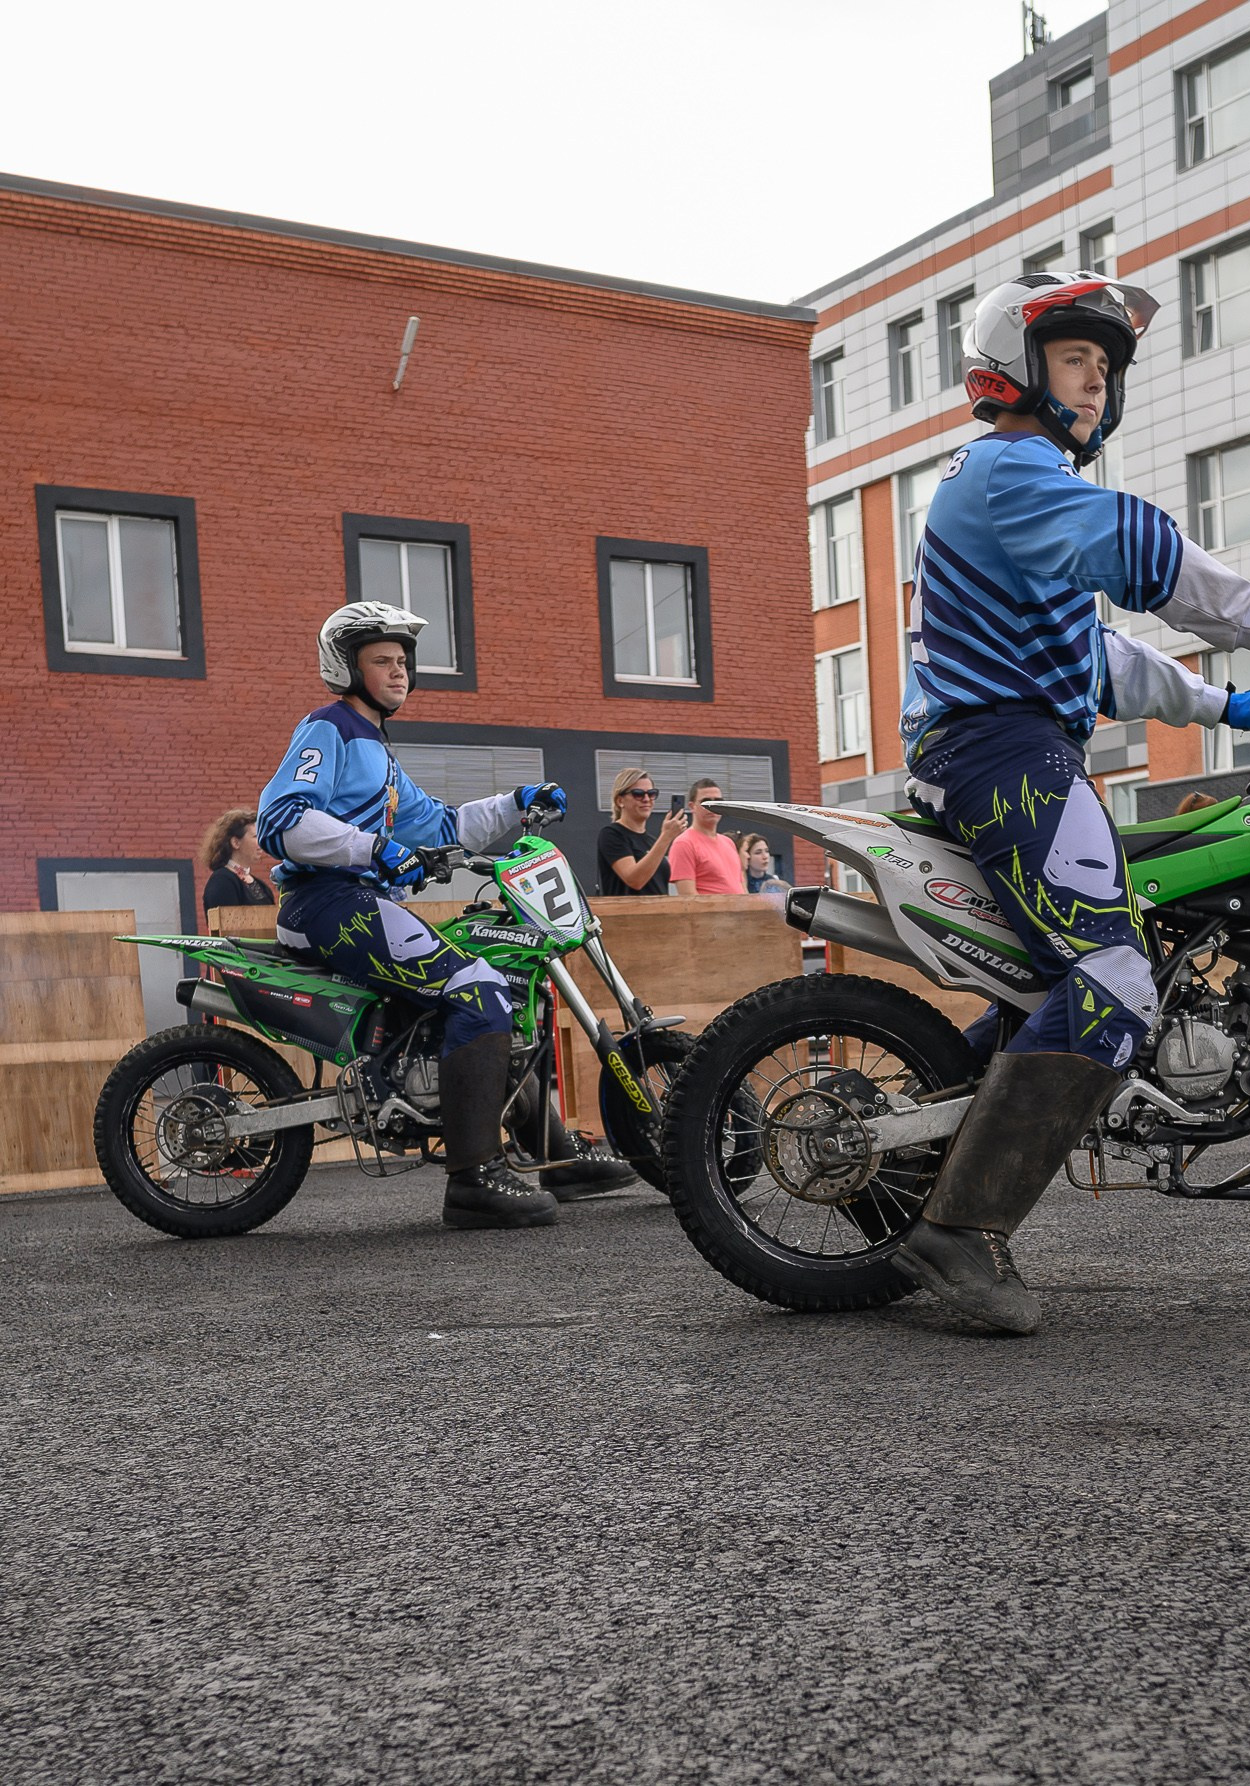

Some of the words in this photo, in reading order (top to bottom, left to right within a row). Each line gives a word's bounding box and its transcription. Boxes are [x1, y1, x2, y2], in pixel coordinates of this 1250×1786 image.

[293, 747, 323, 784] 2
[397, 855, 420, 874] EXPERT
[883, 853, 914, 869] UFO
[535, 866, 574, 922] 2
[160, 939, 223, 948] DUNLOP
[471, 924, 539, 947] Kawasaki
[1046, 931, 1078, 959] UFO
[942, 933, 1034, 980] DUNLOP
[416, 987, 441, 997] UFO
[1074, 977, 1086, 989] S1
[608, 1051, 652, 1112] ACERBIS
